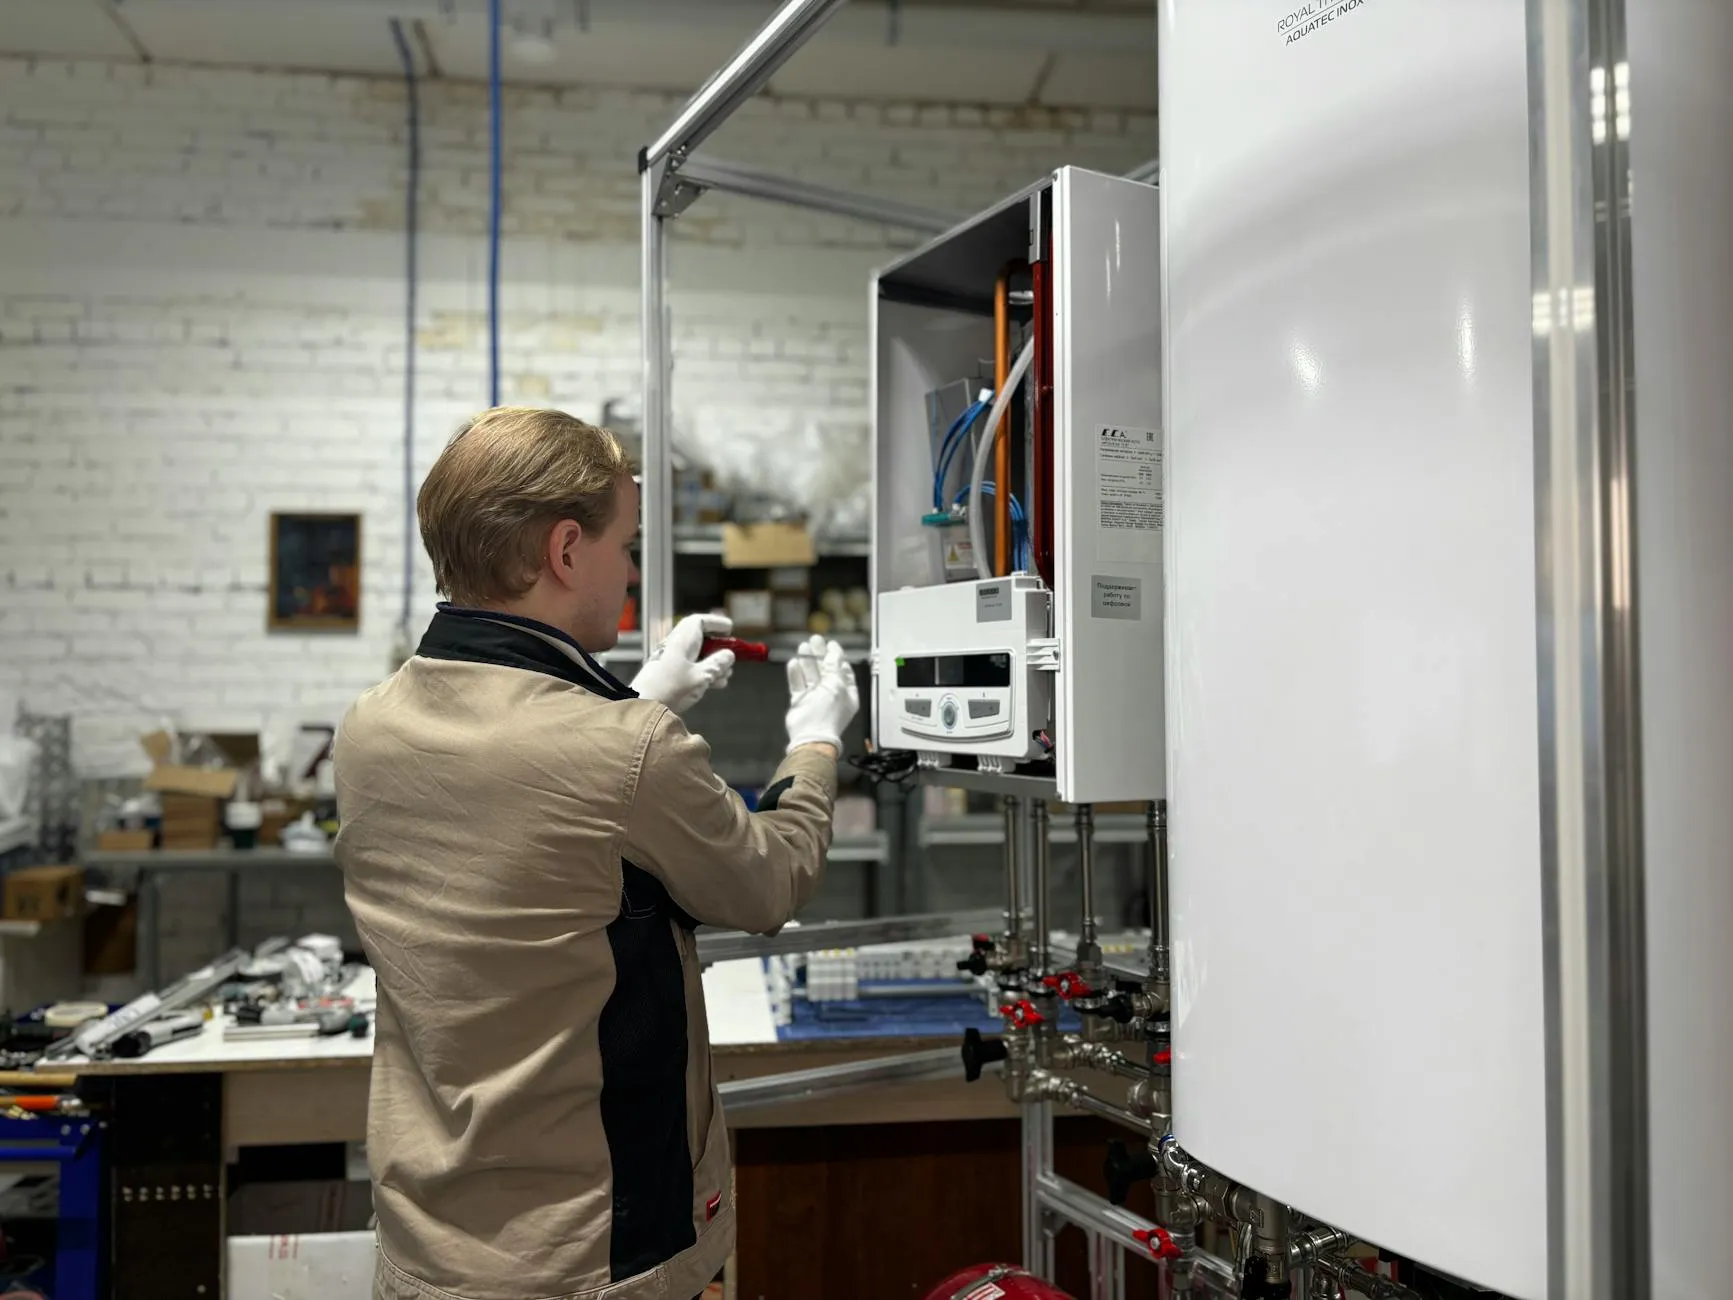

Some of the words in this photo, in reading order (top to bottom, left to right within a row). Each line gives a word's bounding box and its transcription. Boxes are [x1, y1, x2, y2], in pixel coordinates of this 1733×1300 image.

[1277, 3, 1316, 33] ROYAL
[1285, 10, 1335, 47] AQUATEC
[1337, 0, 1364, 17] INOX
